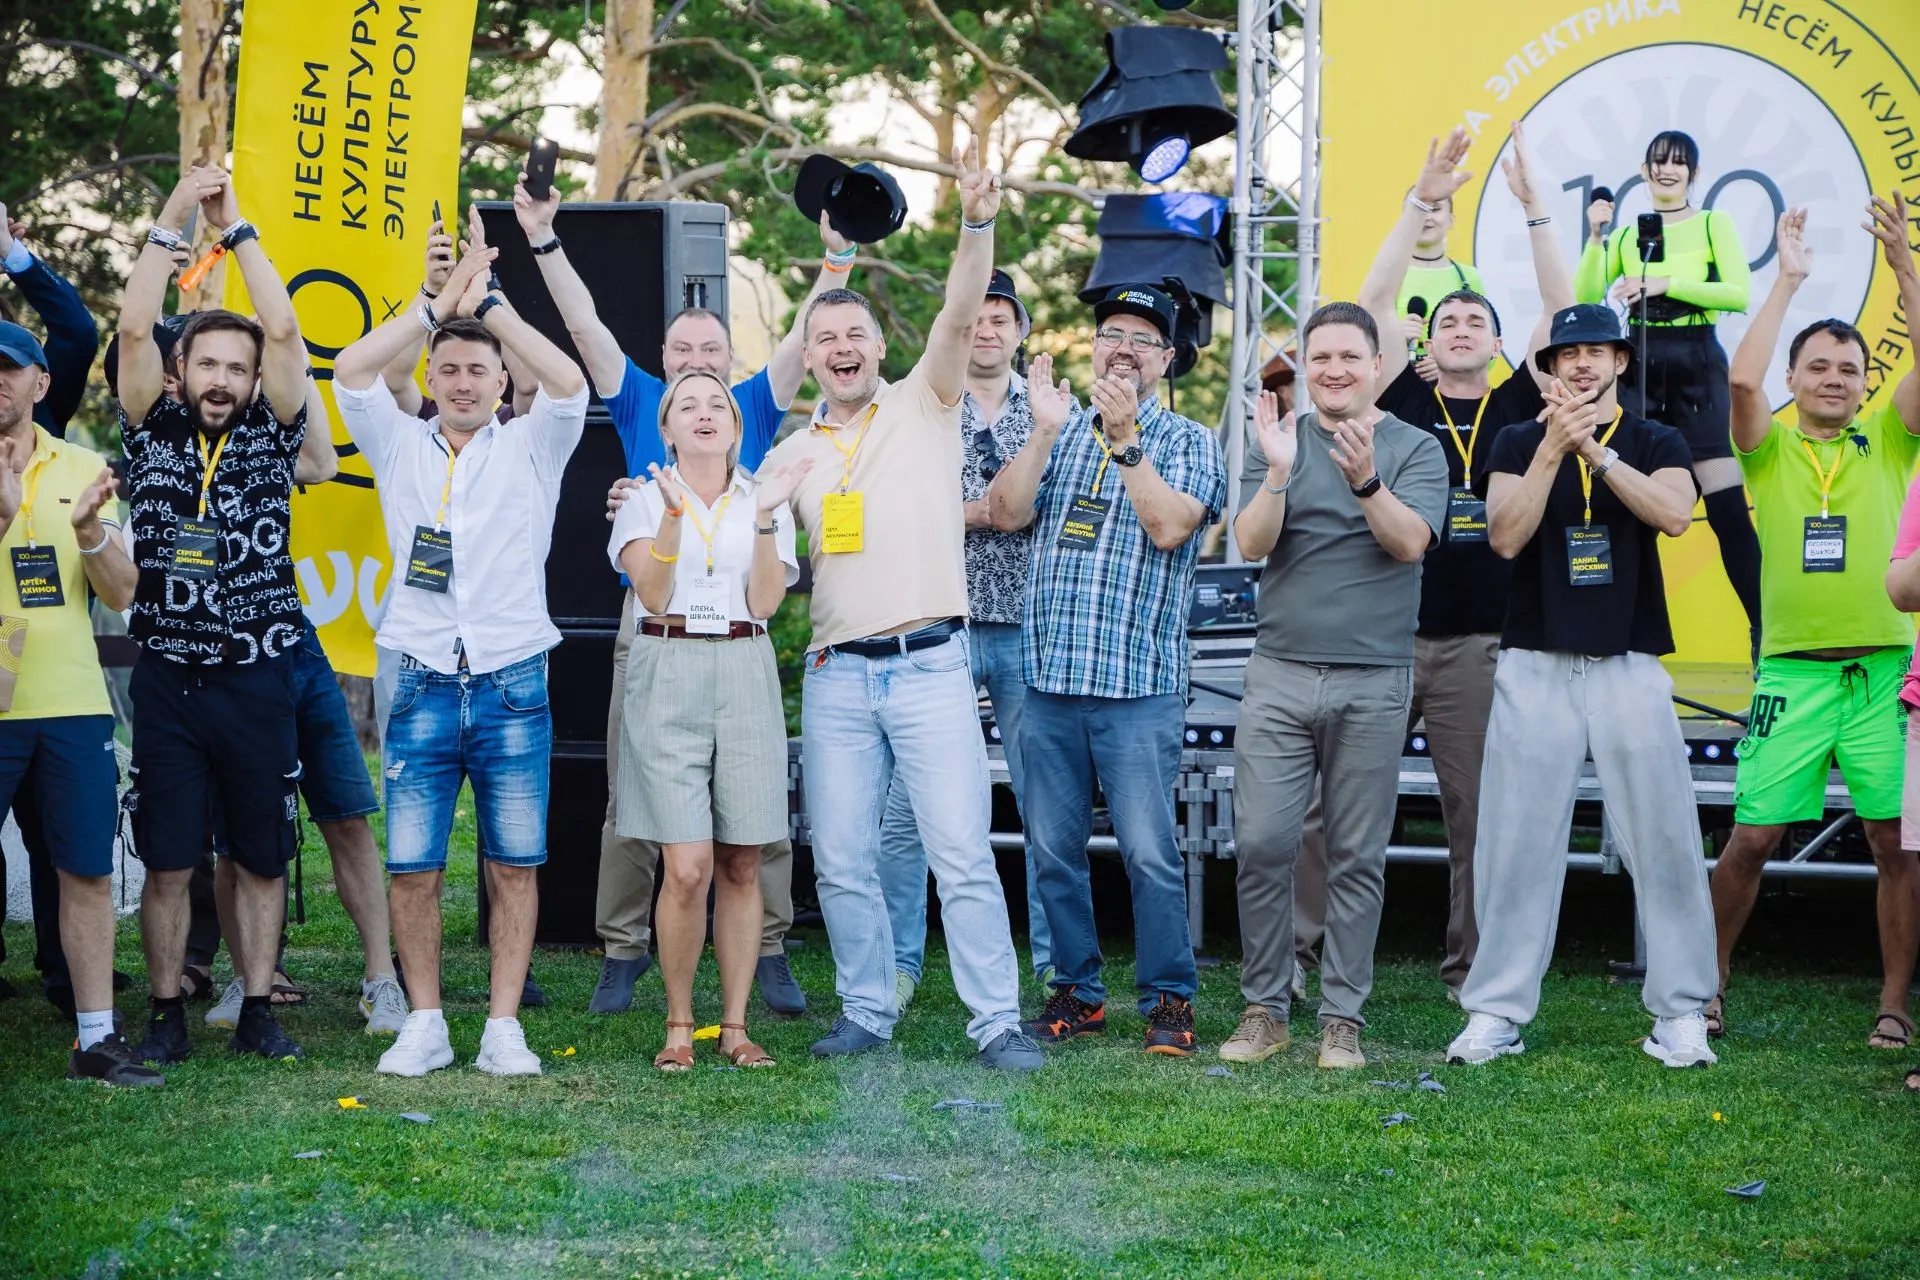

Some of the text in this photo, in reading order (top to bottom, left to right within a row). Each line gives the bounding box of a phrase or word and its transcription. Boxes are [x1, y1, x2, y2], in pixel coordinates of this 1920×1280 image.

[1738, 0, 1853, 69] НЕСЁМ
[383, 0, 422, 240] ЭЛЕКТРОМ
[293, 61, 329, 222] НЕСЁМ
[1127, 290, 1155, 303] ДЕЛАЮ
[1066, 520, 1094, 531] ЕВГЕНИЙ
[1063, 527, 1096, 539] МАШУТИН
[176, 549, 202, 558] СЕРГЕЙ
[175, 556, 214, 566] ДМИТРИЕВ
[1572, 556, 1598, 565] ДАНИЛ
[1572, 563, 1609, 571] МОСКВИН
[20, 577, 47, 587] АРТЁМ
[22, 585, 57, 594] АКИМОВ
[690, 604, 715, 612] ЕЛЕНА
[689, 613, 726, 621] ШВАРЁВА
